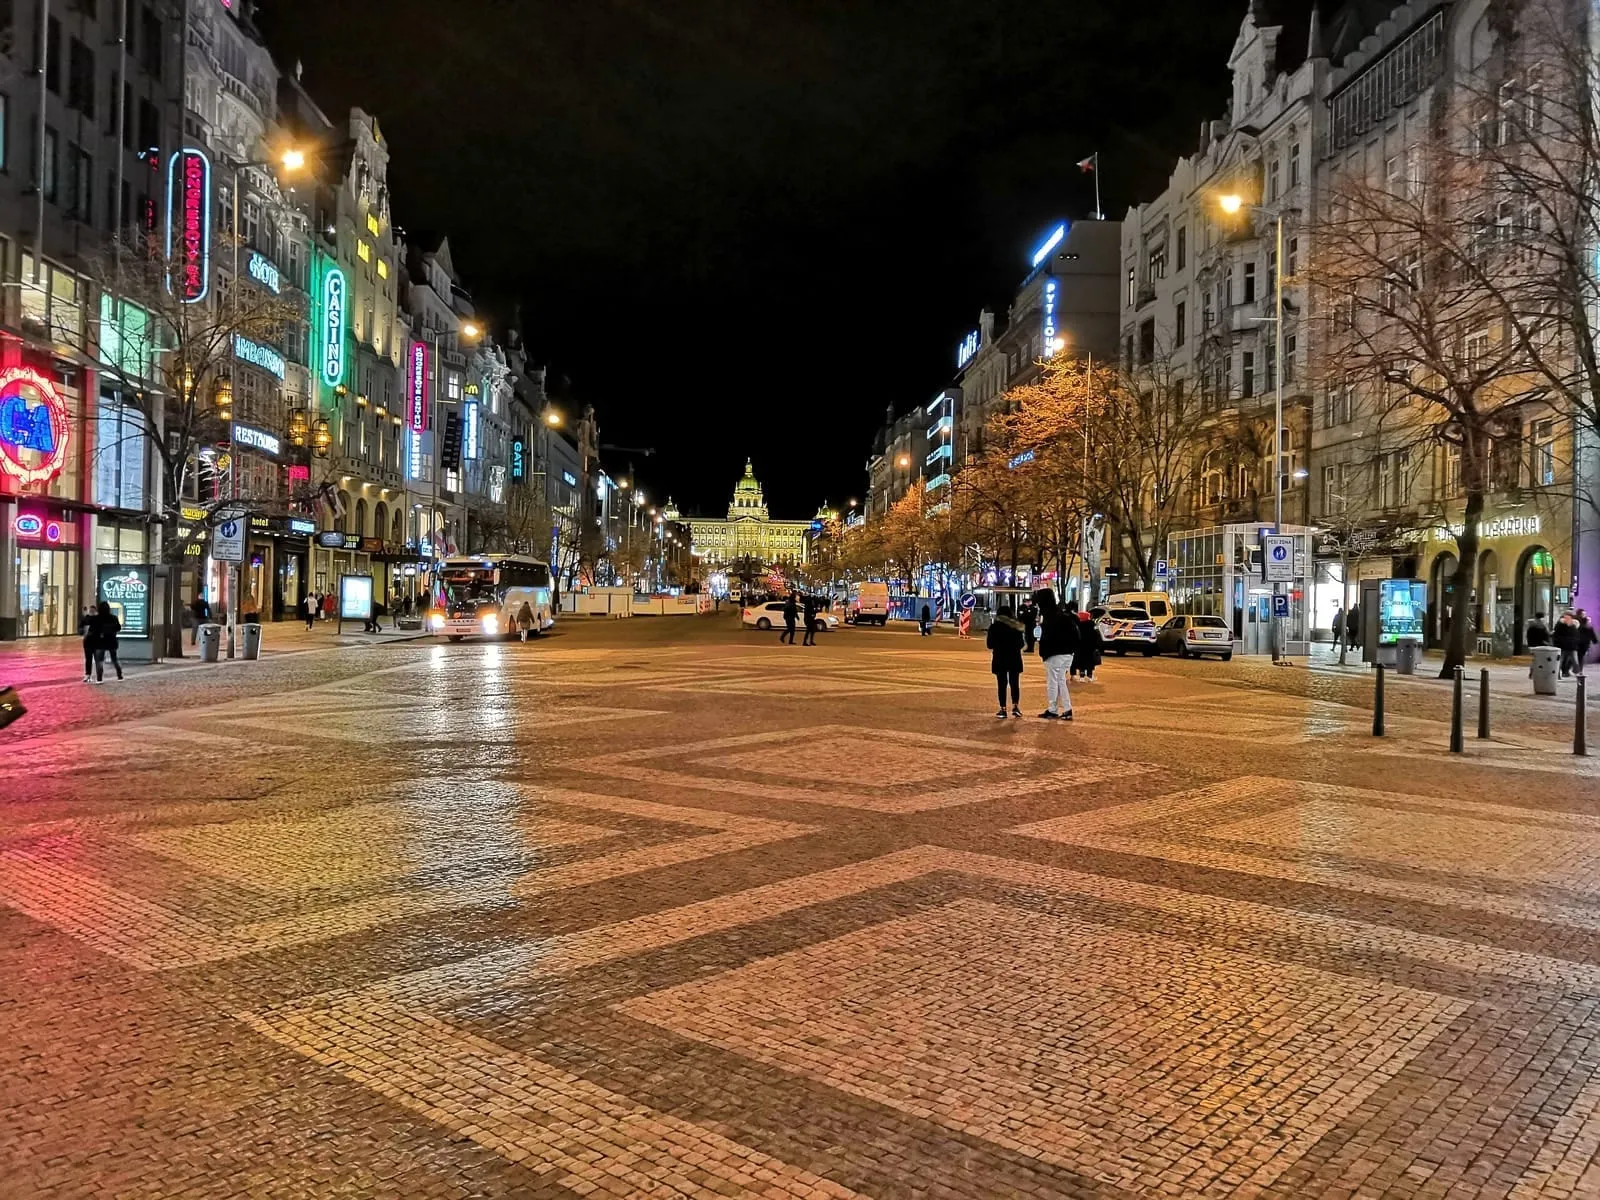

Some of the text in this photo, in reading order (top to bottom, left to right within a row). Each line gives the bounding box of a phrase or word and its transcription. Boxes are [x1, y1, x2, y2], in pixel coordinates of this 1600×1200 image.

[1044, 282, 1056, 358] PYTLOUN
[328, 278, 341, 377] CASINO
[513, 441, 523, 477] GATE
[251, 517, 269, 527] hotel
[1158, 562, 1166, 573] P
[103, 580, 147, 592] CASINO
[1274, 597, 1286, 611] P
